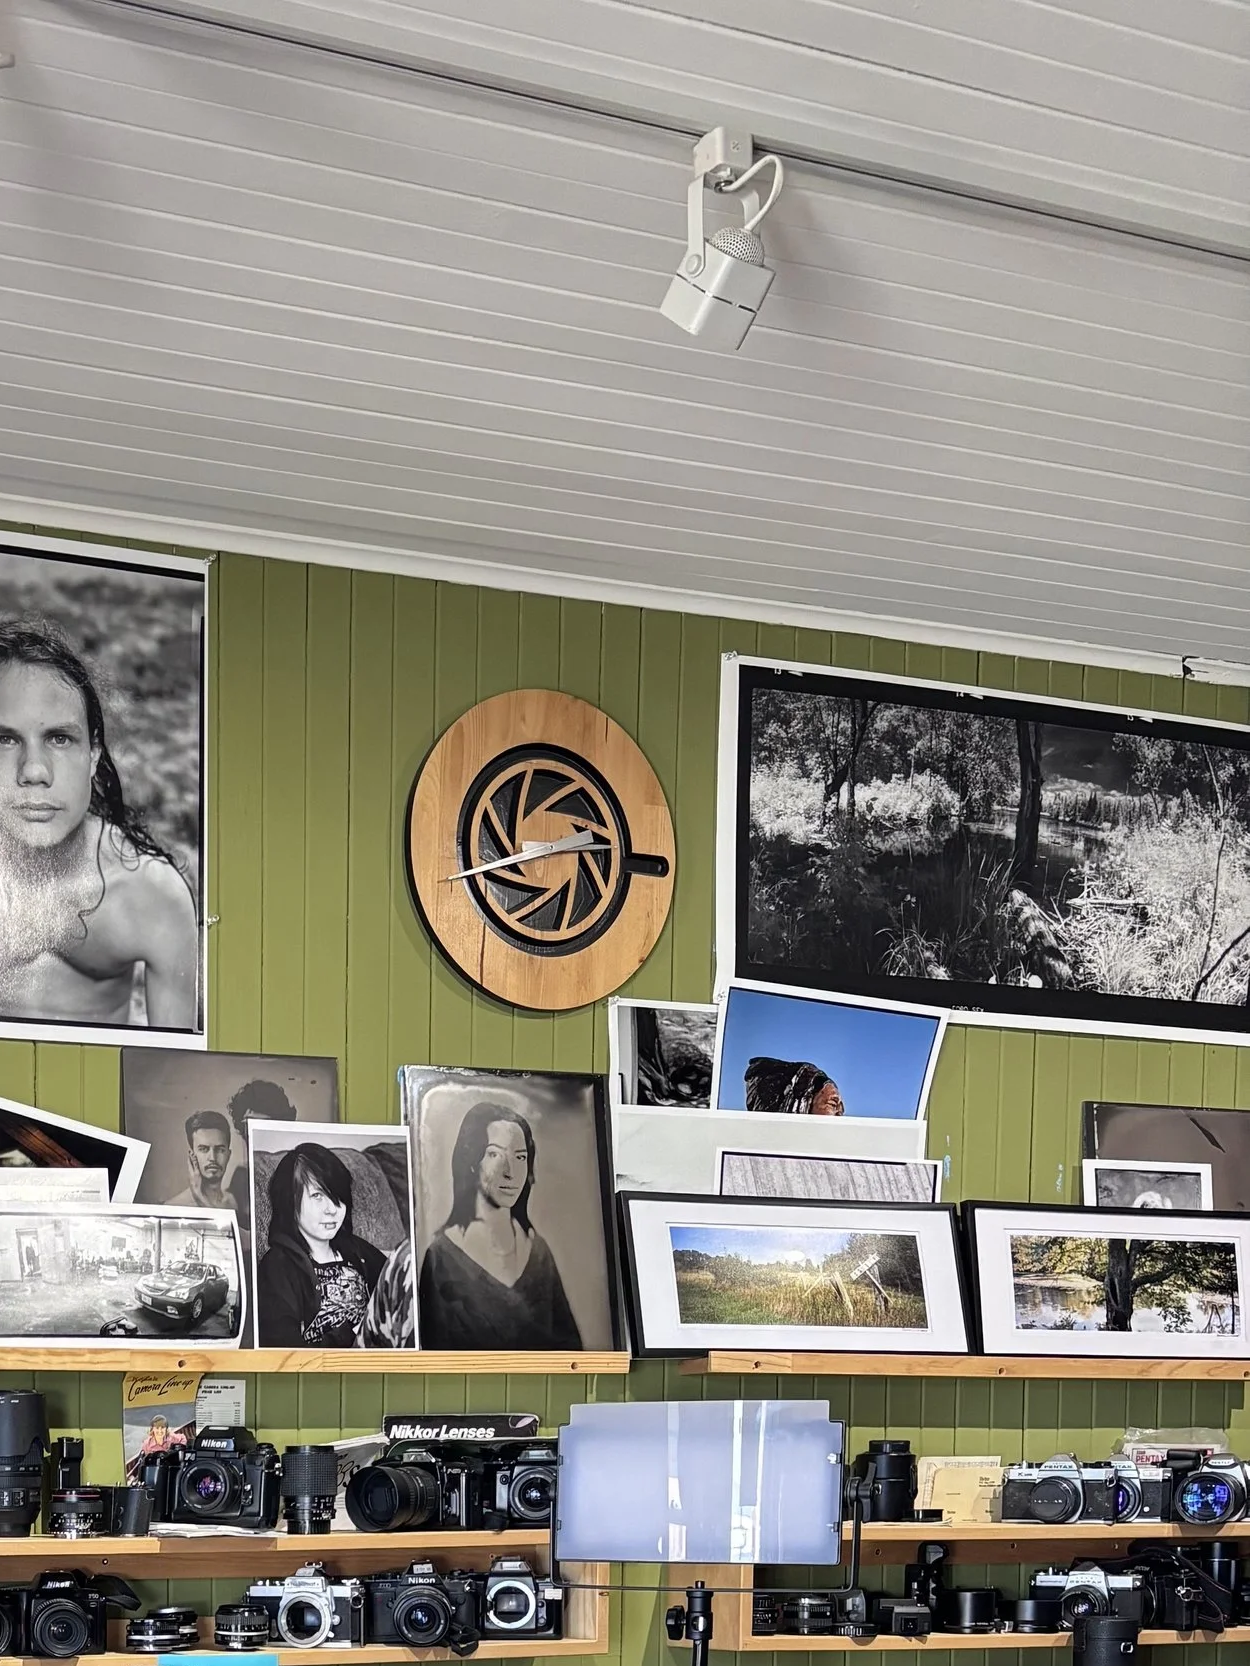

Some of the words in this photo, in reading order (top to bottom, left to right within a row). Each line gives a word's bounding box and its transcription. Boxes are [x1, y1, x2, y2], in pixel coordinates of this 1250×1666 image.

[128, 1380, 160, 1401] Camera
[390, 1424, 439, 1439] Nikkor
[439, 1426, 495, 1438] Lenses
[201, 1439, 227, 1448] Nikon
[1136, 1455, 1166, 1463] PENTAX
[46, 1581, 74, 1589] Nikon
